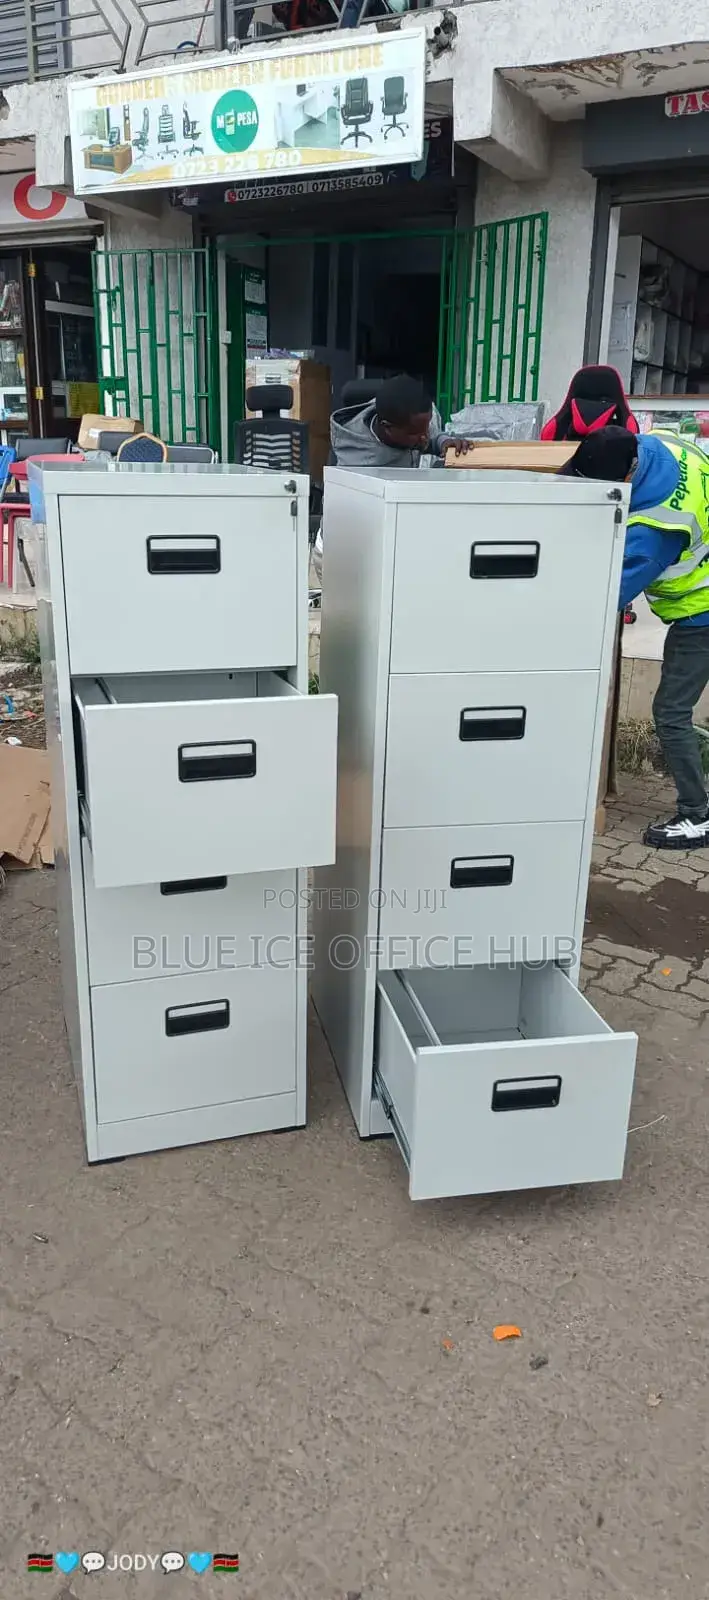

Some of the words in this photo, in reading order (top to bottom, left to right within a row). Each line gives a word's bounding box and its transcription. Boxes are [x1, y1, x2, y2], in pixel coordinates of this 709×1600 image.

[237, 111, 257, 126] PESA
[263, 149, 302, 169] 780
[238, 183, 304, 200] 0723226780
